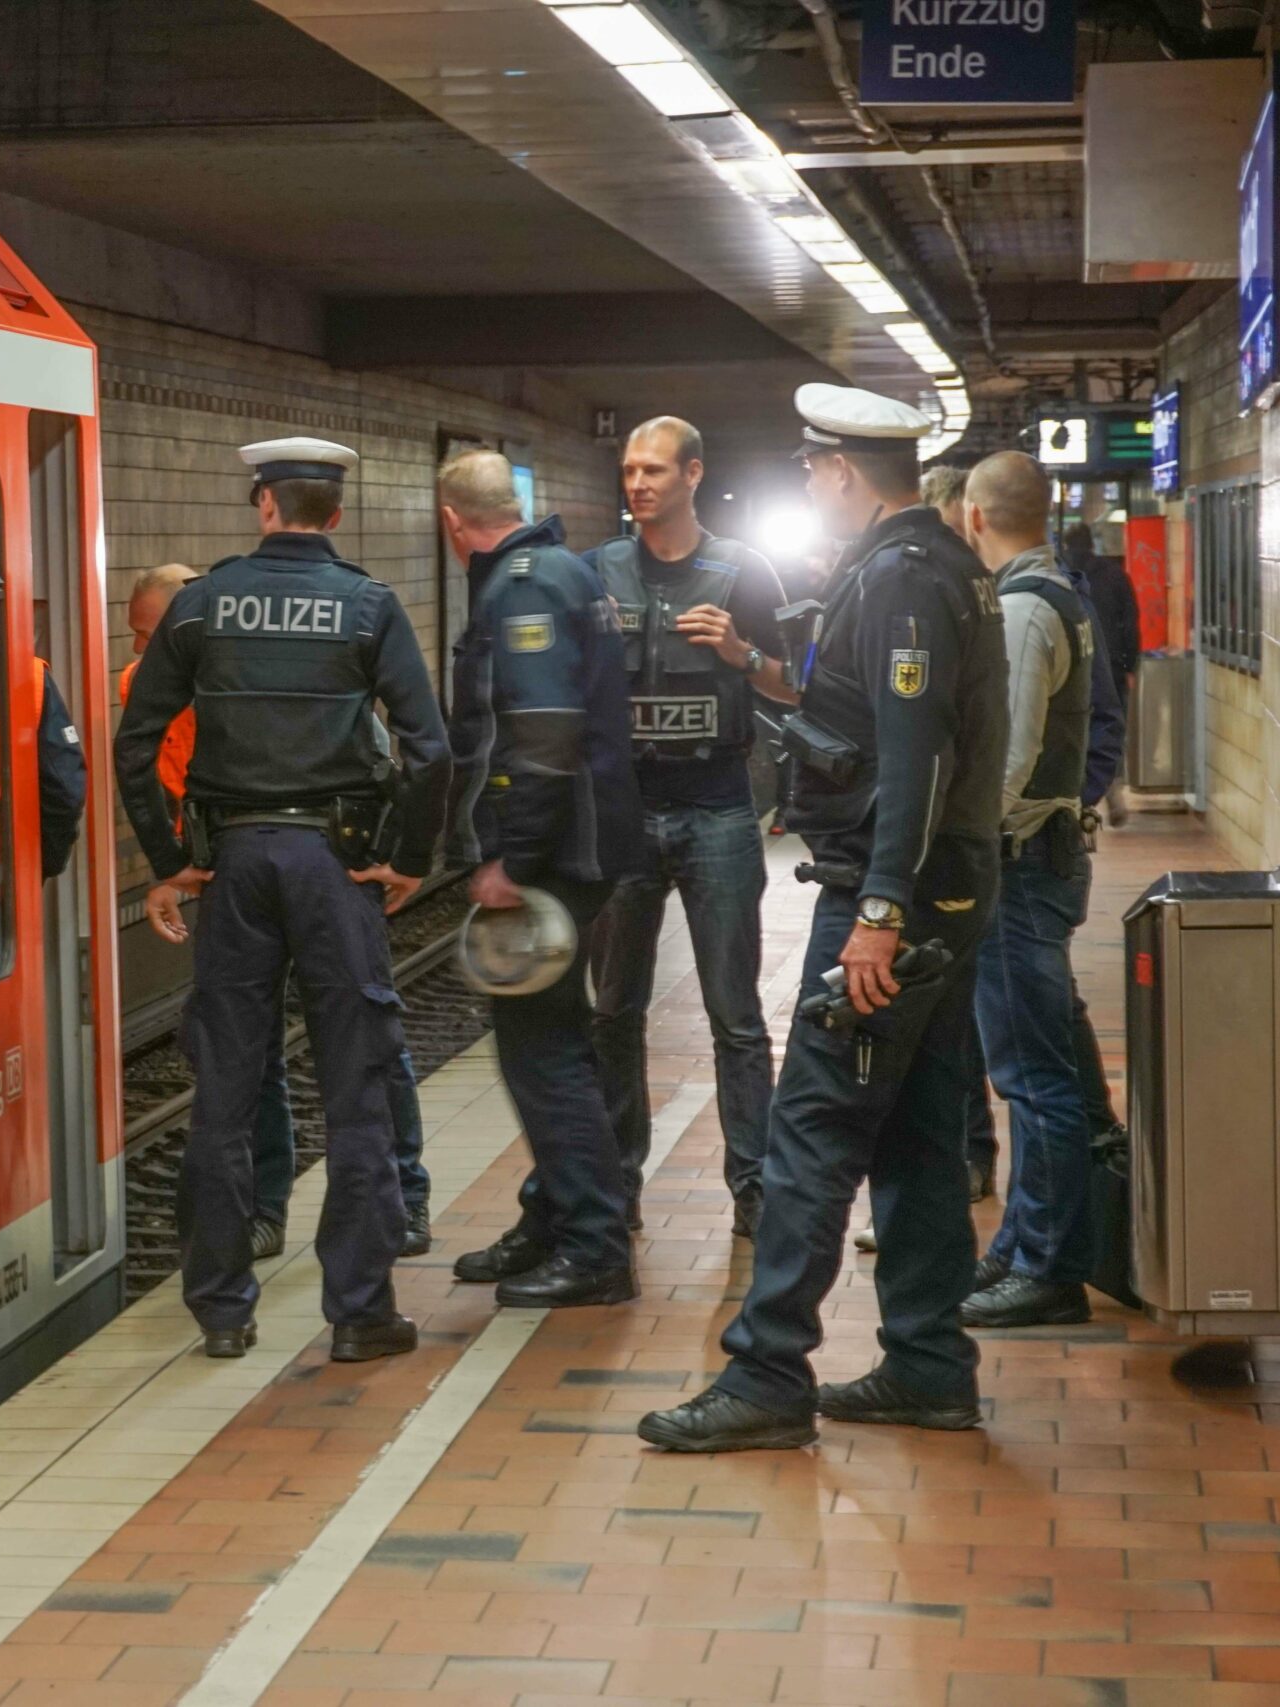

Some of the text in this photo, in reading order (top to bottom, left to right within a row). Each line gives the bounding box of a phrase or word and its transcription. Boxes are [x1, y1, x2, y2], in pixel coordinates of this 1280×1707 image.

[893, 0, 1046, 34] Kurzzug
[891, 44, 987, 79] Ende
[597, 411, 615, 436] H
[216, 595, 342, 634] POLIZEI
[632, 702, 712, 732] LIZEI
